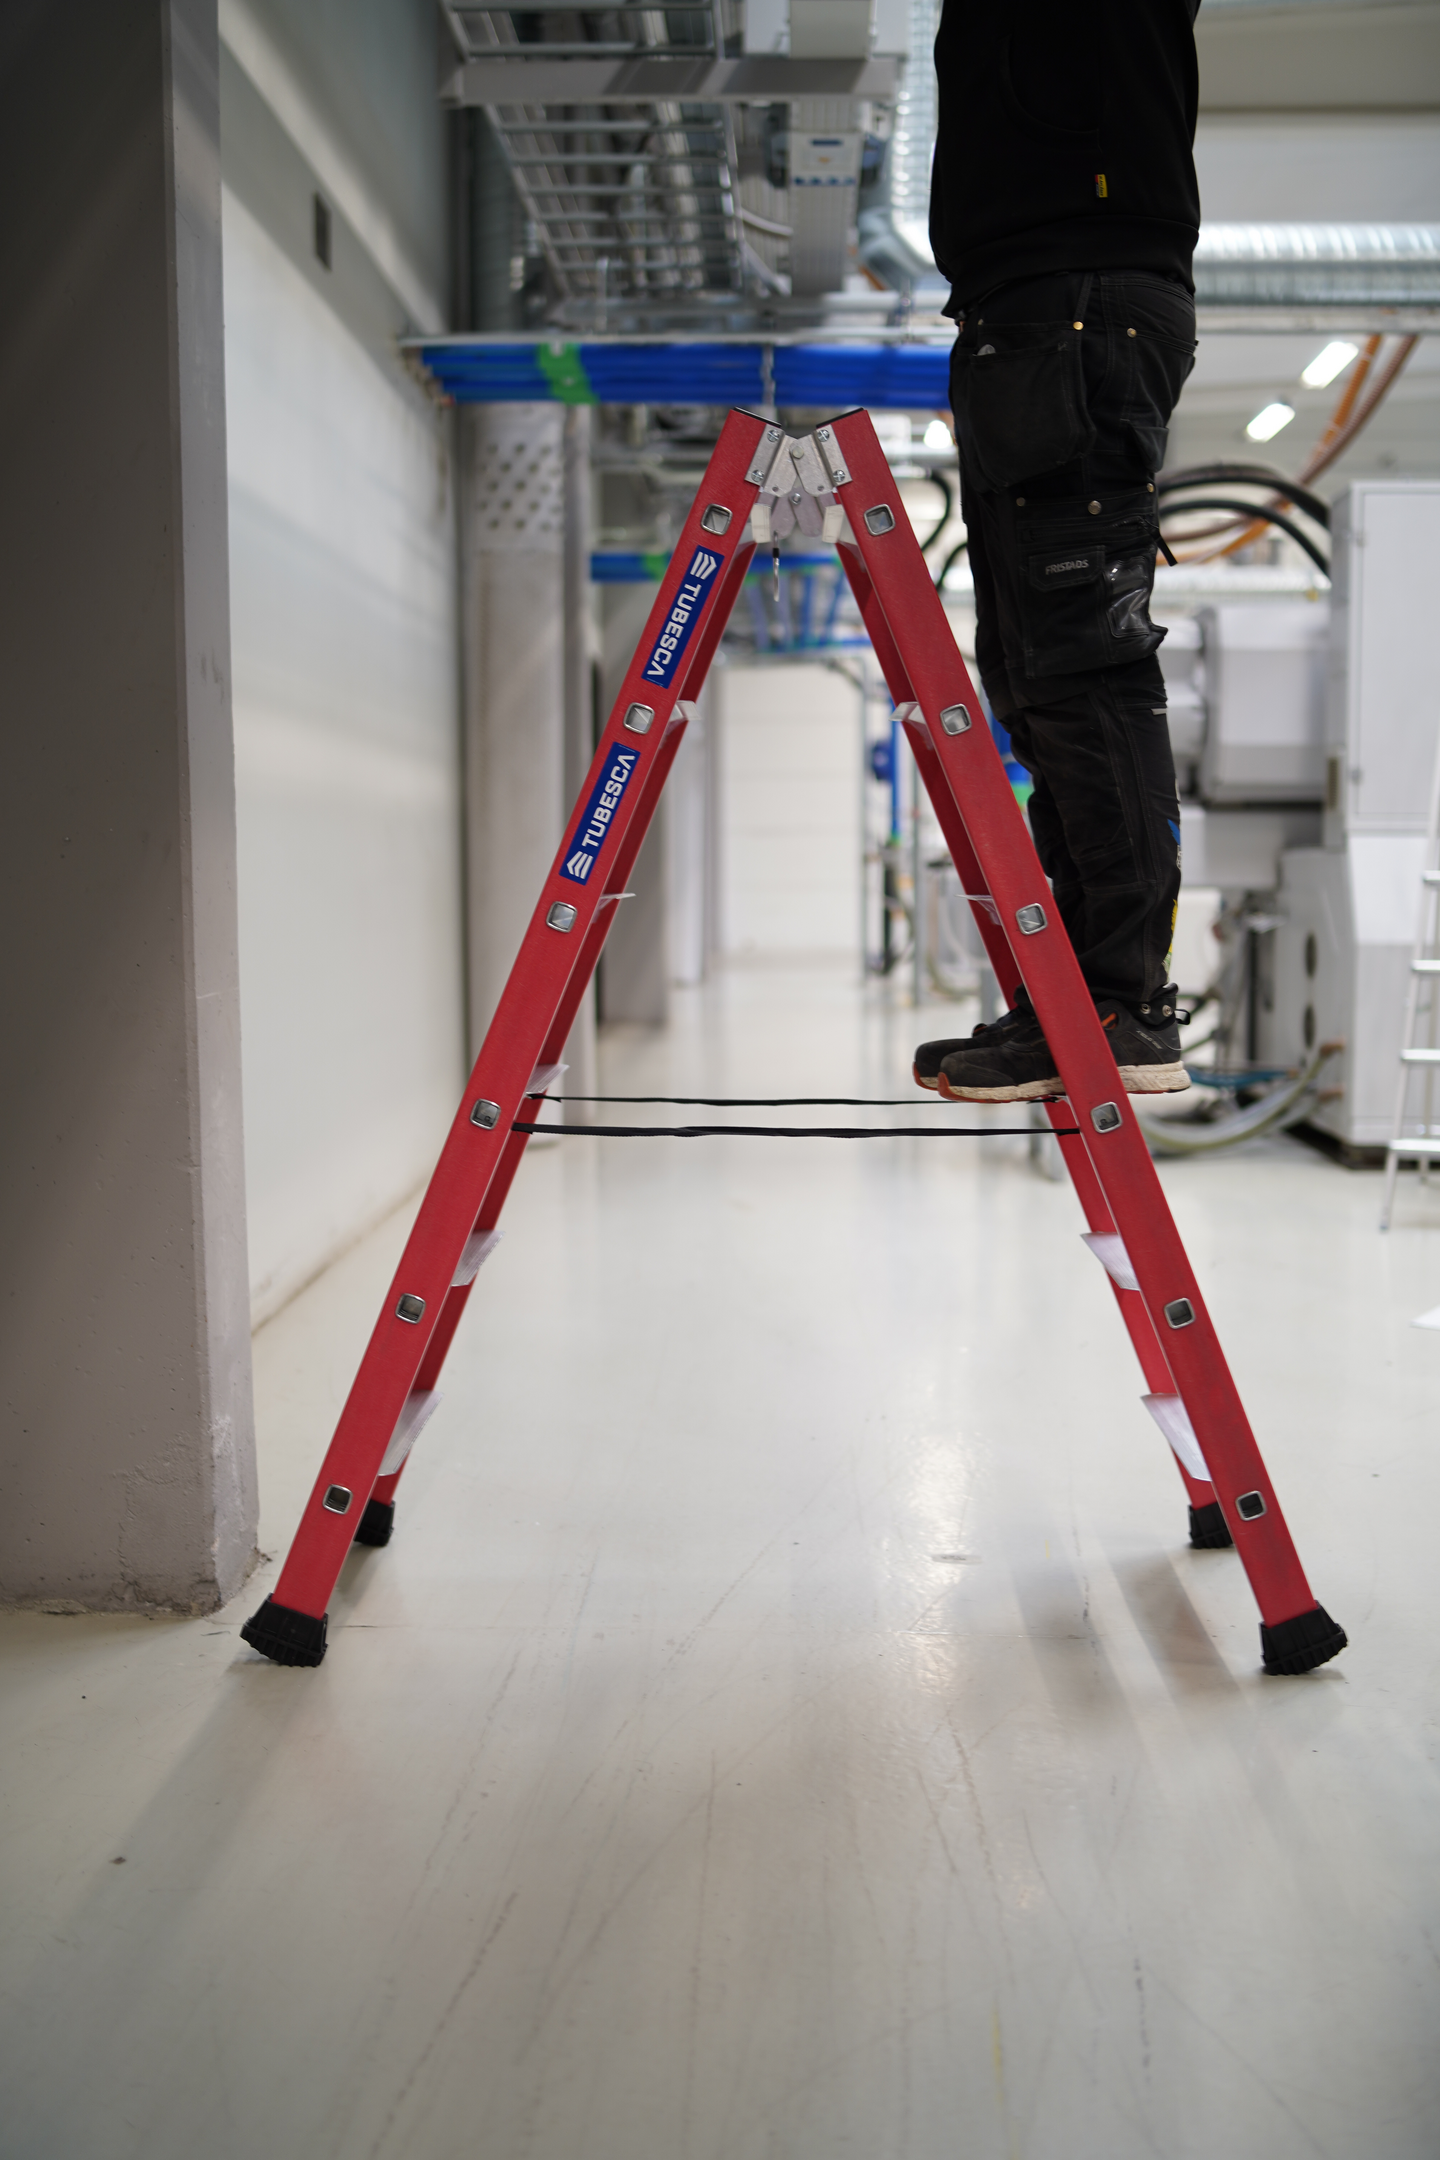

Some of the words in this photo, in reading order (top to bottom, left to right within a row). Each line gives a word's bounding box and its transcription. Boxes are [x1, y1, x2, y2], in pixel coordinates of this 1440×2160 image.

[1045, 559, 1089, 575] FRISTADS
[646, 582, 703, 677] TUBESCA
[580, 754, 637, 849] TUBESCA
